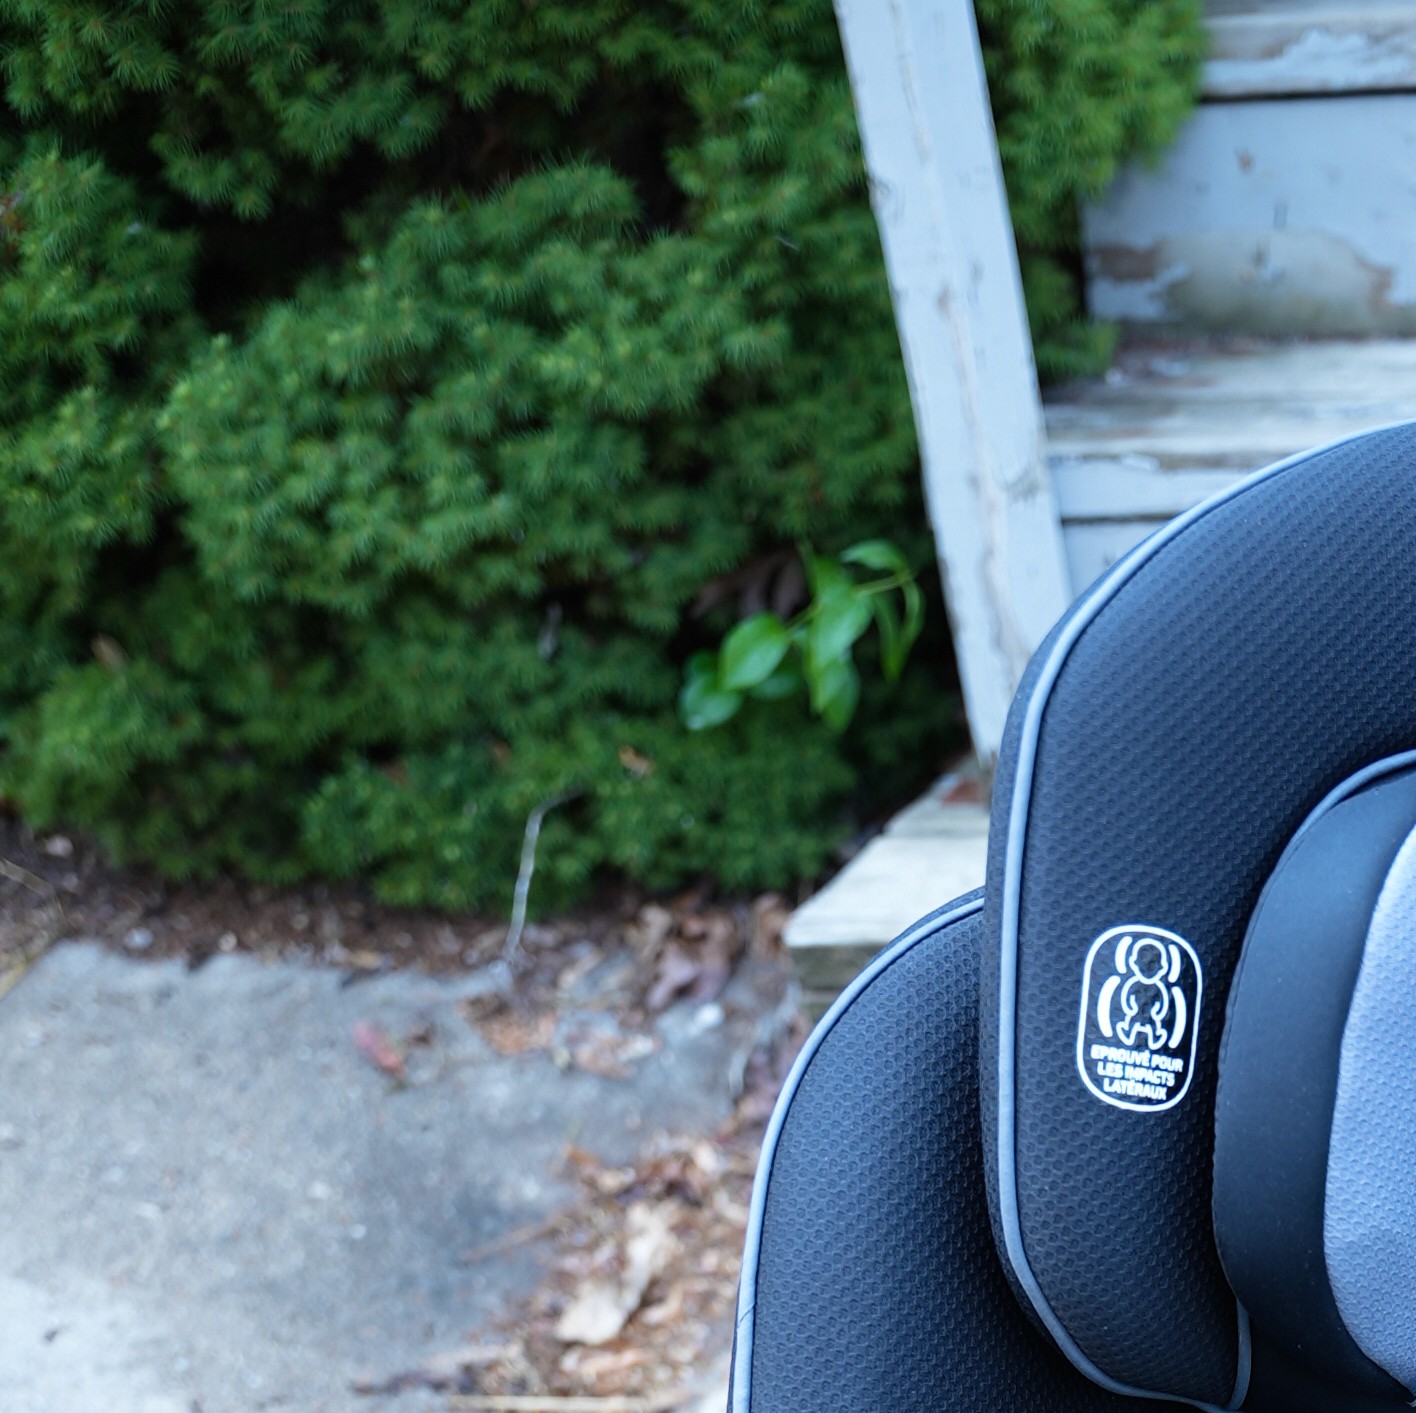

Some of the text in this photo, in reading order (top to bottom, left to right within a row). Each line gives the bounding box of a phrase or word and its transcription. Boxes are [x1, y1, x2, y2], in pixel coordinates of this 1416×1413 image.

[1097, 1061, 1176, 1087] LES IMPACTS
[1151, 1053, 1184, 1073] POUR
